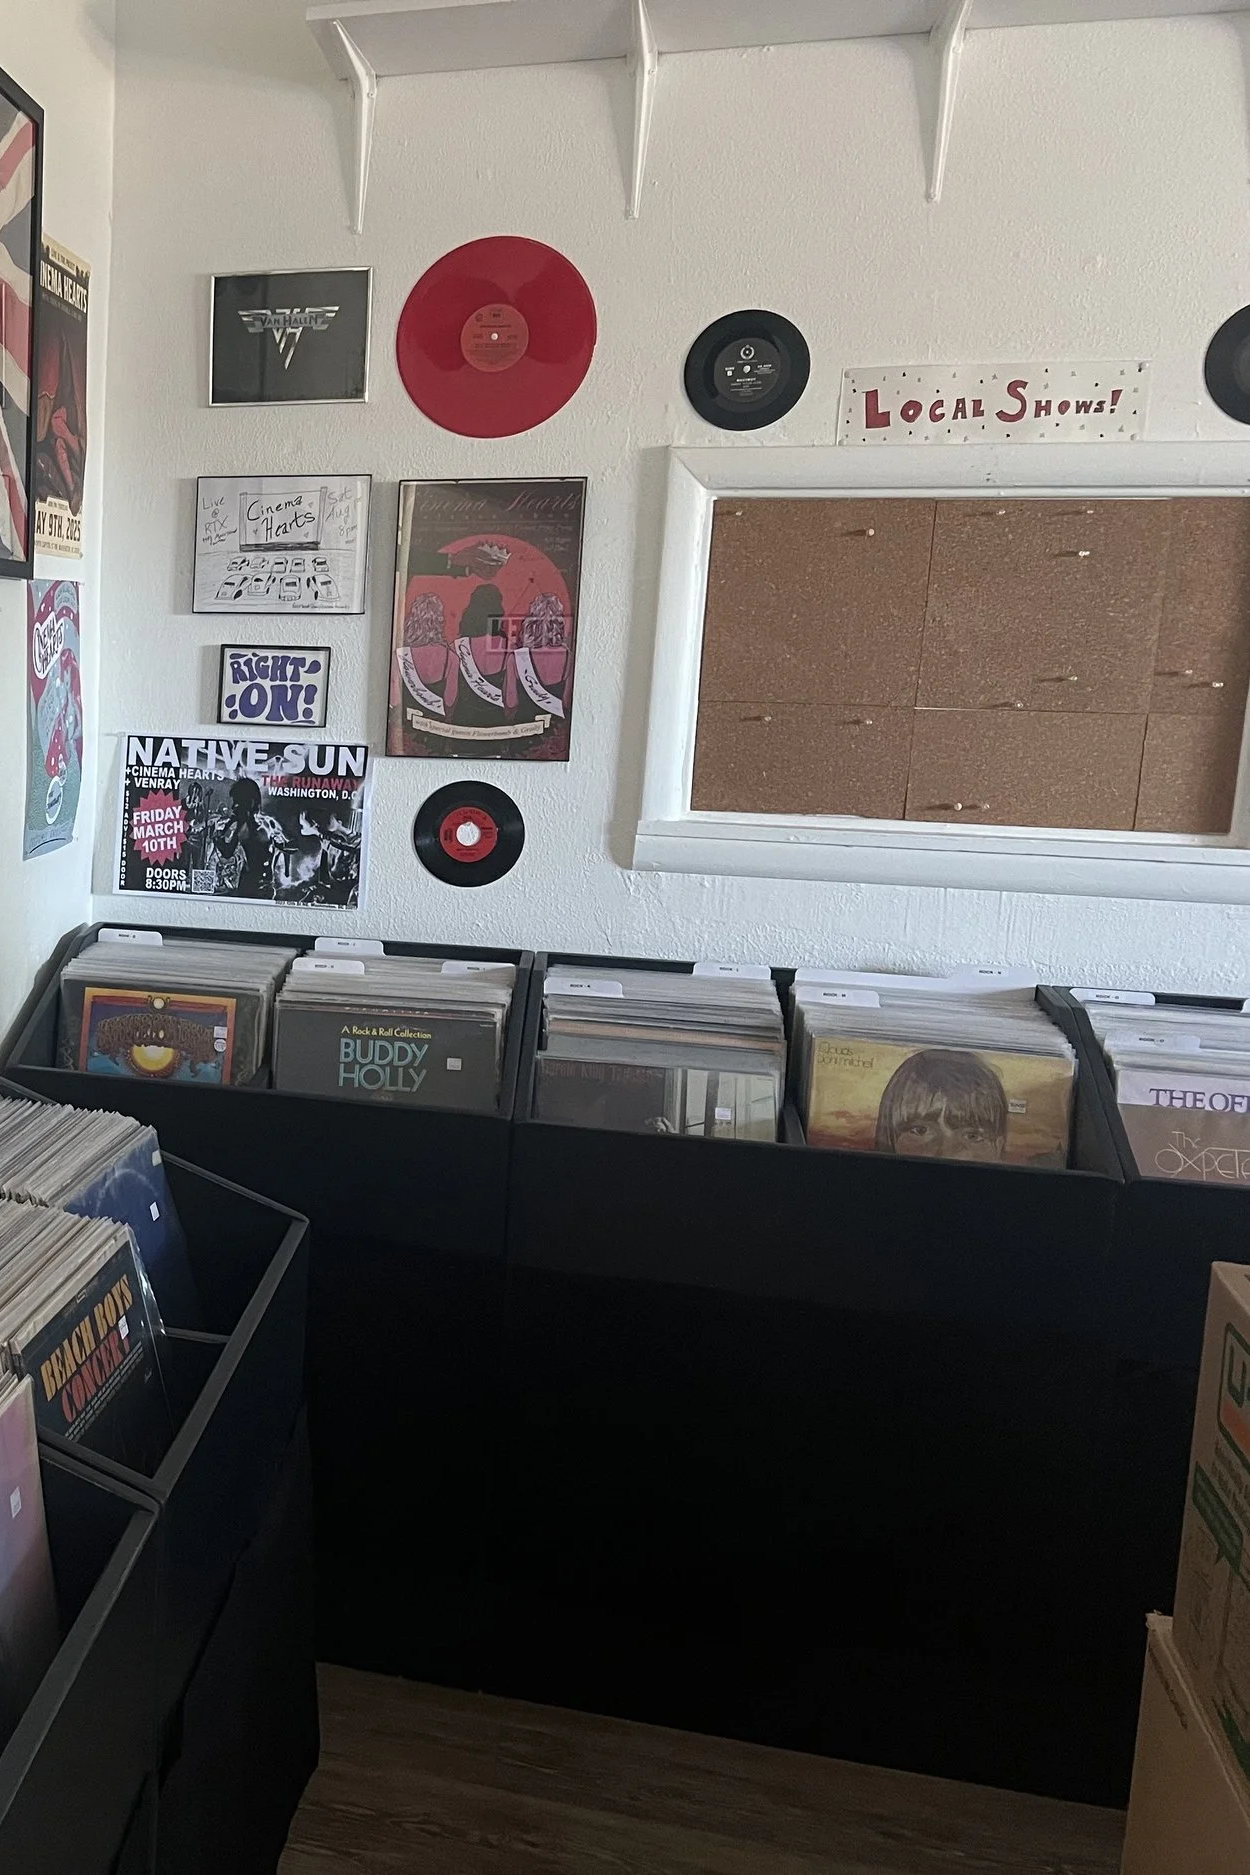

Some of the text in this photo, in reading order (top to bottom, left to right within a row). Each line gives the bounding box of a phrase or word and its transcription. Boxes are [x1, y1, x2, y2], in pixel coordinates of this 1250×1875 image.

[64, 275, 87, 314] HEARTS
[247, 495, 303, 521] Cinema
[66, 517, 81, 542] 2025
[261, 512, 316, 542] Hearts
[230, 655, 307, 684] RIGHT
[239, 683, 318, 722] ON!
[128, 736, 366, 777] NATIVE SUN
[125, 766, 225, 781] +CINEMA HEARTS
[134, 777, 181, 790] VENRAY
[268, 786, 339, 801] WASHINGTON,
[292, 777, 361, 793] RUNAWAY
[133, 805, 183, 825] FRIDAY
[133, 820, 184, 840] MARCH
[142, 836, 177, 853] 10TH
[145, 878, 187, 891] 8:30PM
[146, 867, 187, 880] DOORS
[341, 1025, 432, 1039] A Rock & Roll Collection
[339, 1037, 429, 1067] BUDDY
[338, 1063, 428, 1092] HOLLY
[1149, 1088, 1206, 1110] THE
[40, 1315, 96, 1402] BEACH
[94, 1273, 133, 1340] BOYS
